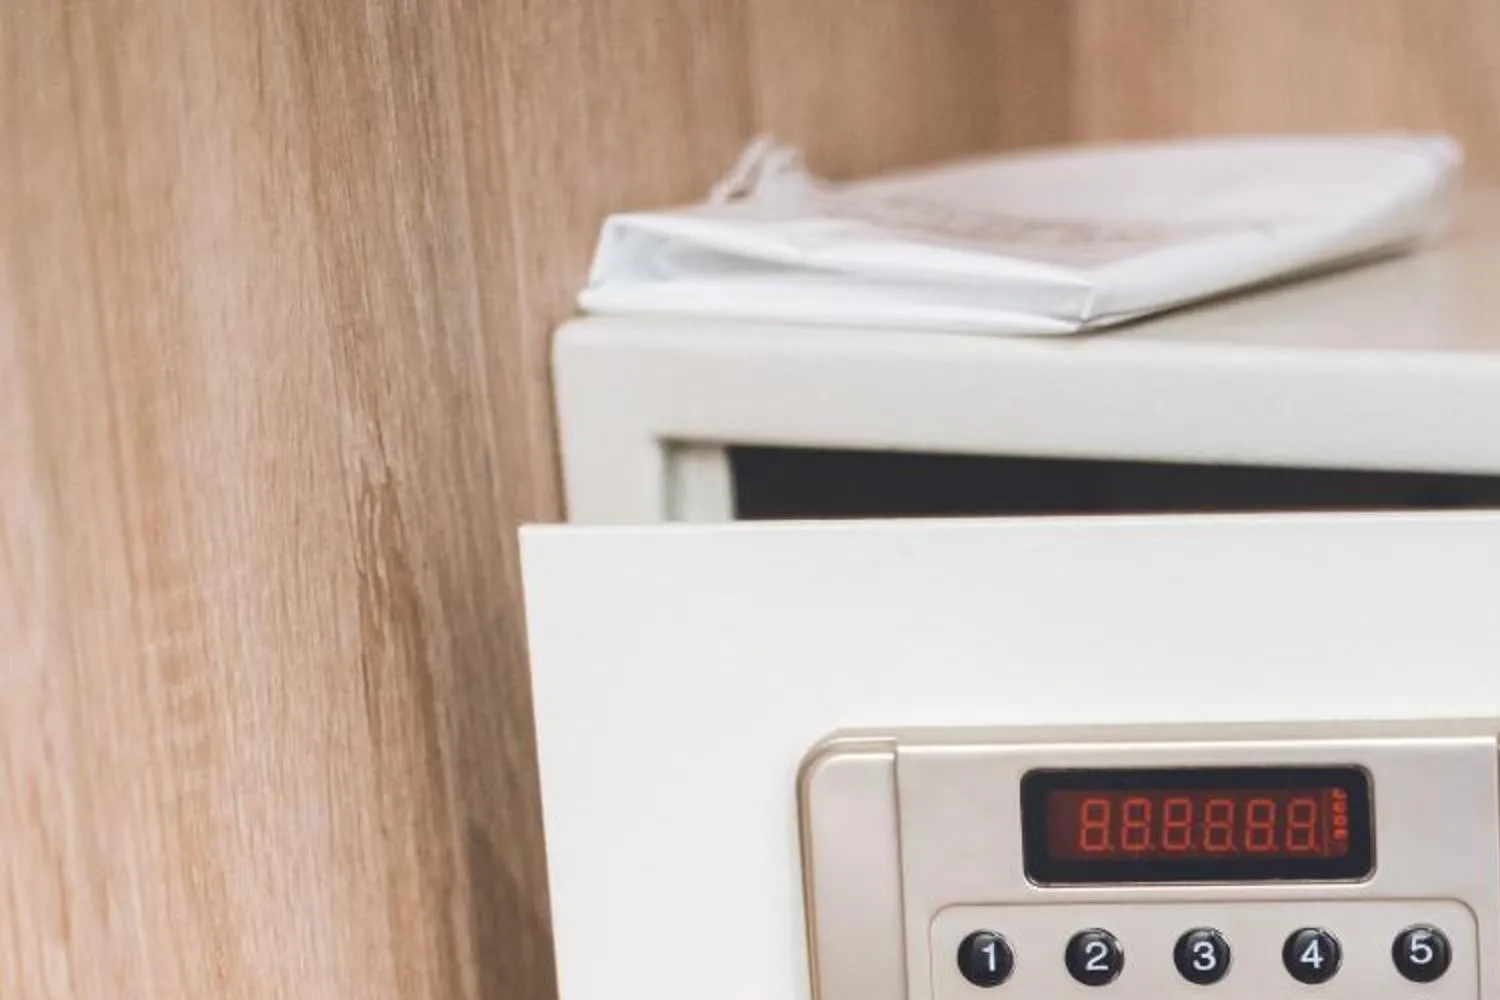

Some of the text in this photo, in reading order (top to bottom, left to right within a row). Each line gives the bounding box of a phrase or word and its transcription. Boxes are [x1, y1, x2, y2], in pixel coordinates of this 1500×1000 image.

[981, 936, 1434, 972] 1 2 3 4 5
